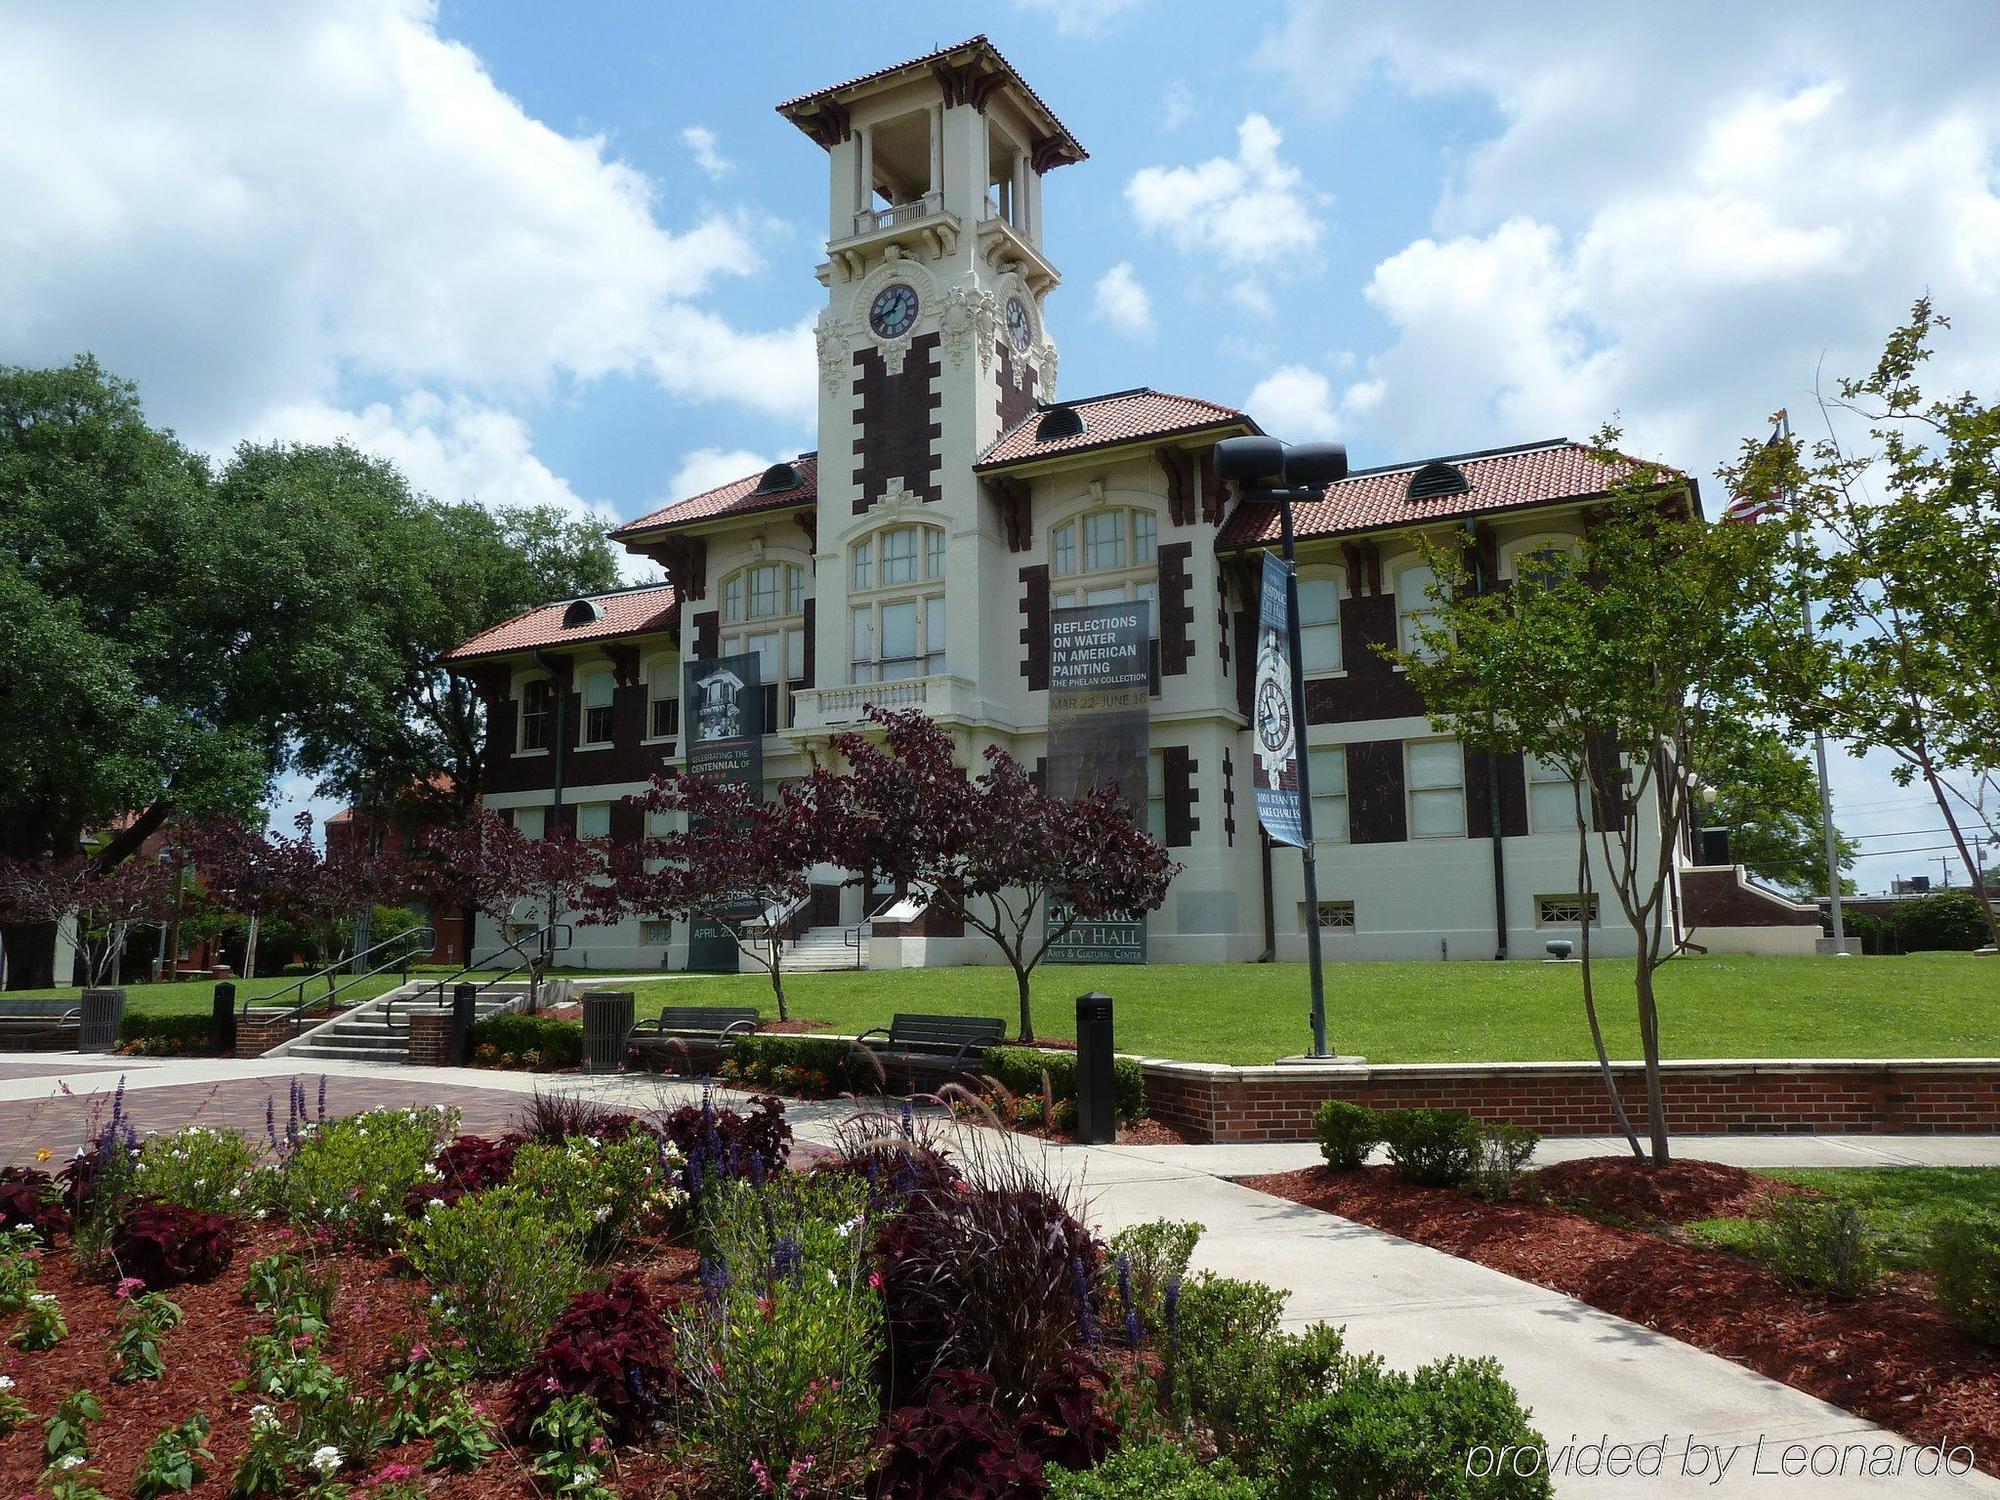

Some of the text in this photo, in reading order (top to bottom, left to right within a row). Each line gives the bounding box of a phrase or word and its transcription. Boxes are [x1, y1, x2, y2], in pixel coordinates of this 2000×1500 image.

[1054, 616, 1137, 634] REFLECTIONS
[1053, 632, 1116, 649] ON WATER
[1053, 644, 1137, 663] IN AMERICAN
[1053, 661, 1110, 677] PAINTING
[1052, 673, 1147, 688] THE PHELAN COLLECTION
[1051, 698, 1077, 711] MAR
[691, 749, 749, 764] CELEBRATING THE
[691, 760, 751, 774] CENTENNIAL OF
[694, 928, 718, 939] APRIL
[1047, 927, 1141, 945] CITY HALL
[1047, 949, 1141, 959] ARTS & CULTURAL CENTER
